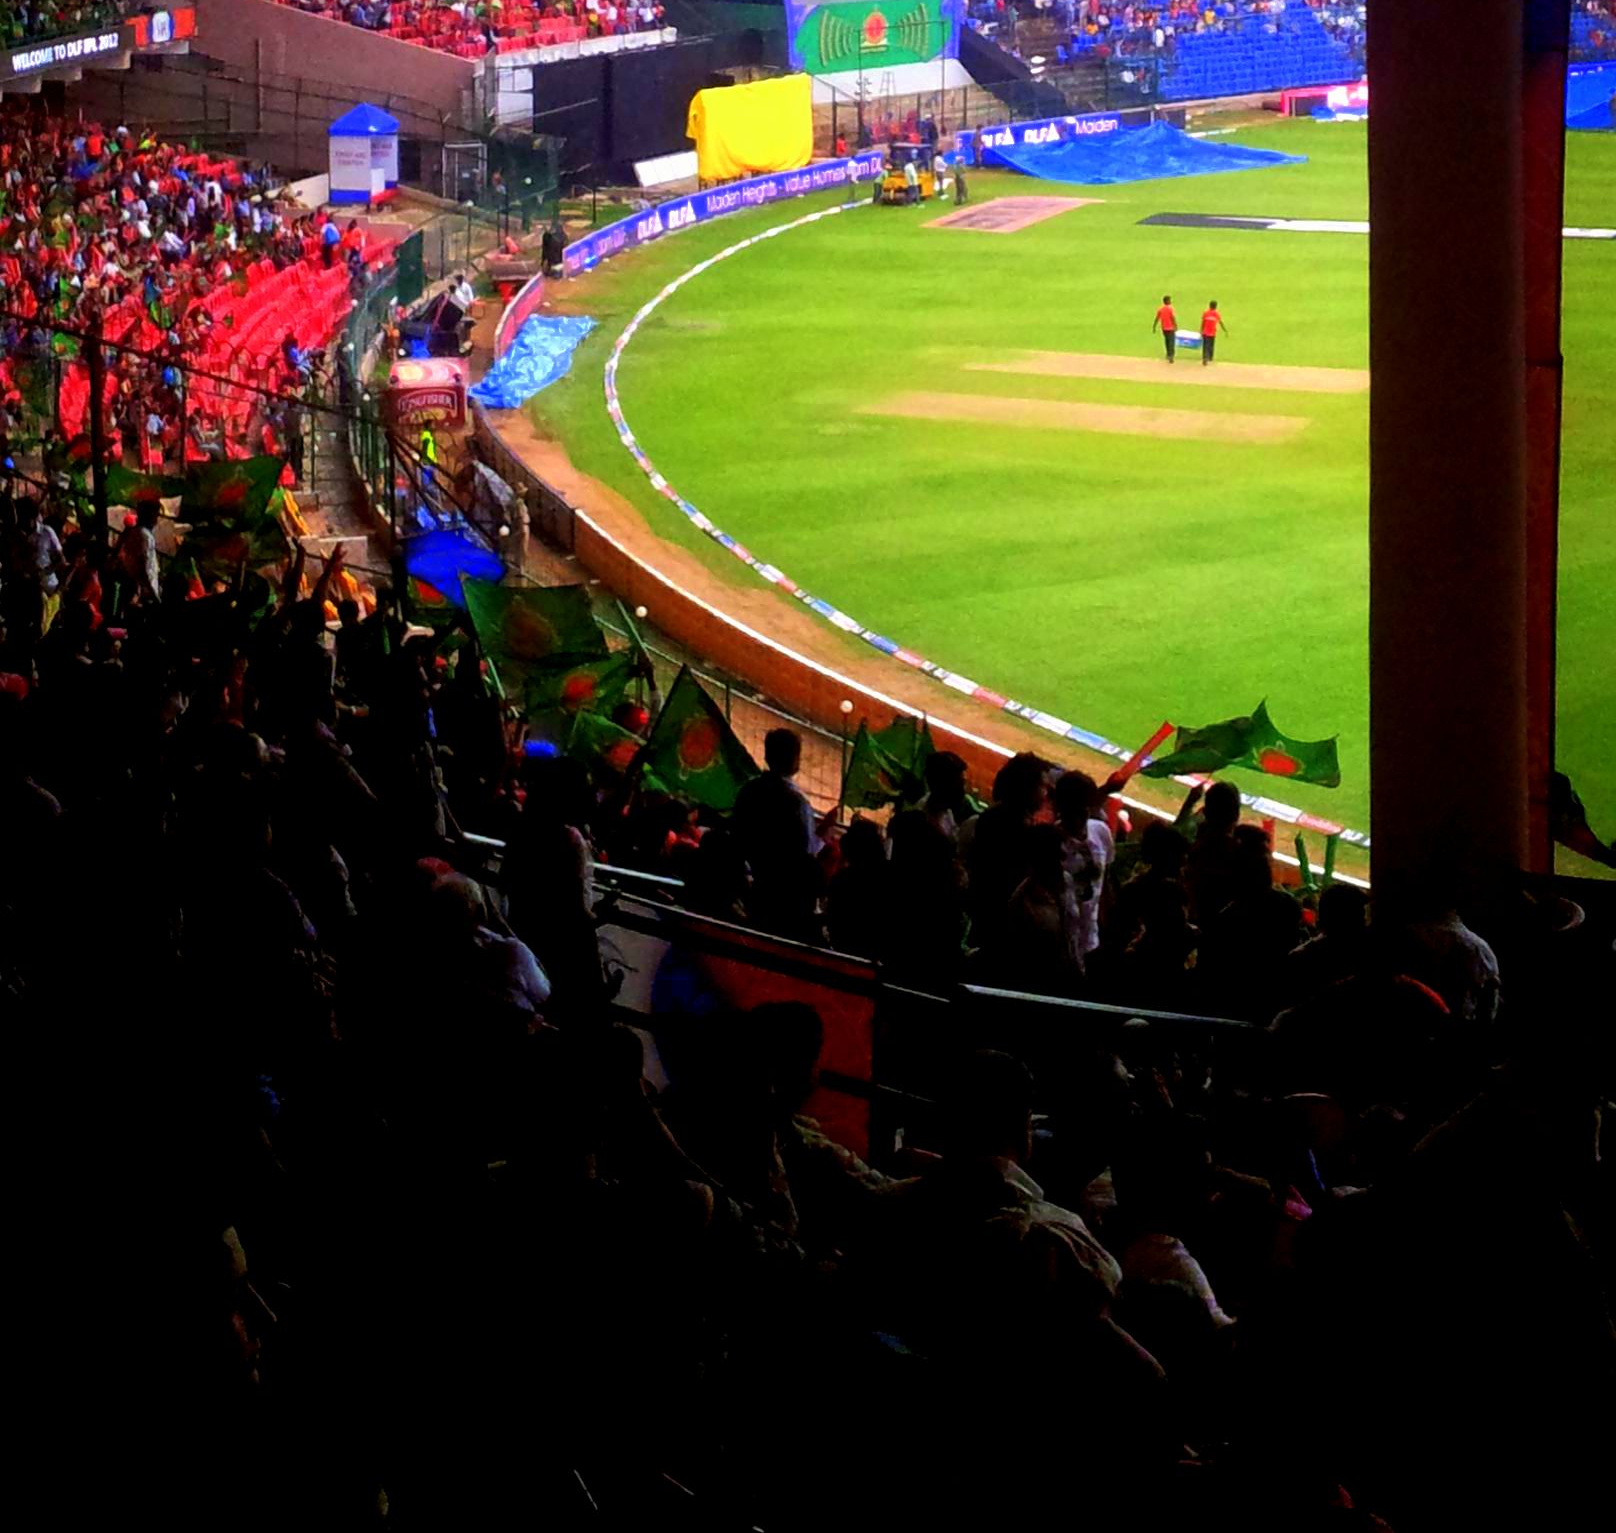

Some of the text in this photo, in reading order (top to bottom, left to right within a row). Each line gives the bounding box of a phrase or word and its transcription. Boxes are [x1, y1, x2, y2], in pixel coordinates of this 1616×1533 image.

[12, 47, 54, 72] WELCOME
[54, 43, 67, 62] TO
[67, 38, 82, 58] DLF
[99, 32, 120, 51] 2012
[1024, 129, 1047, 144] DLF
[1075, 117, 1119, 136] Maiden
[784, 172, 812, 193] Value
